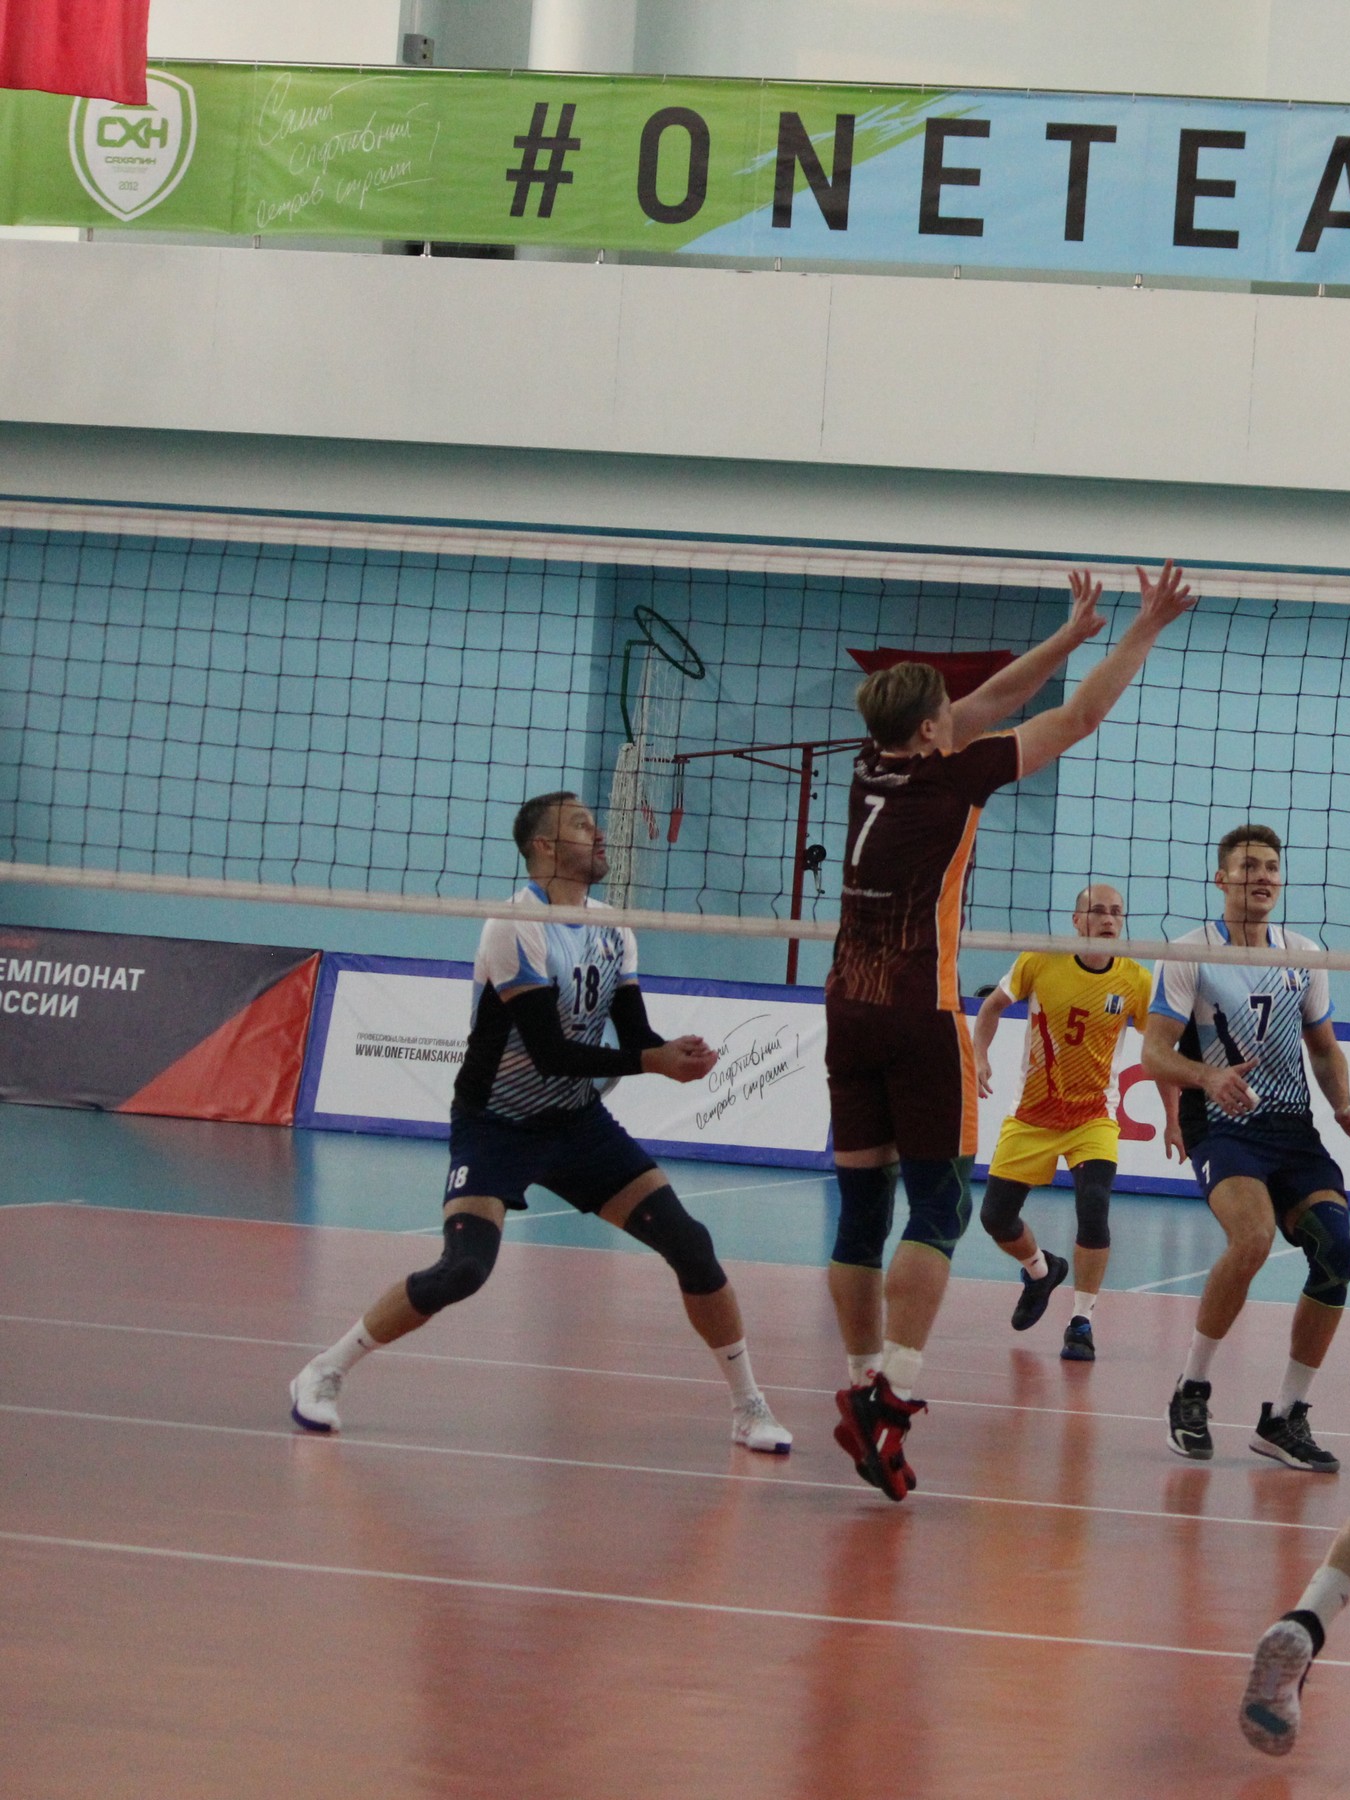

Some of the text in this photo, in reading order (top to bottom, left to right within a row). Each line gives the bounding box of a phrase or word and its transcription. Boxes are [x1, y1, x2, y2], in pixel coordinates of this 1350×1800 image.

[119, 181, 139, 191] 2012
[851, 795, 886, 866] 7
[0, 989, 80, 1019] ССИИ
[571, 964, 602, 1015] 18
[1064, 1006, 1090, 1046] 5
[1249, 994, 1273, 1044] 7
[355, 1043, 466, 1064] WWW.ONETEAMSAKHA
[447, 1165, 469, 1192] 18
